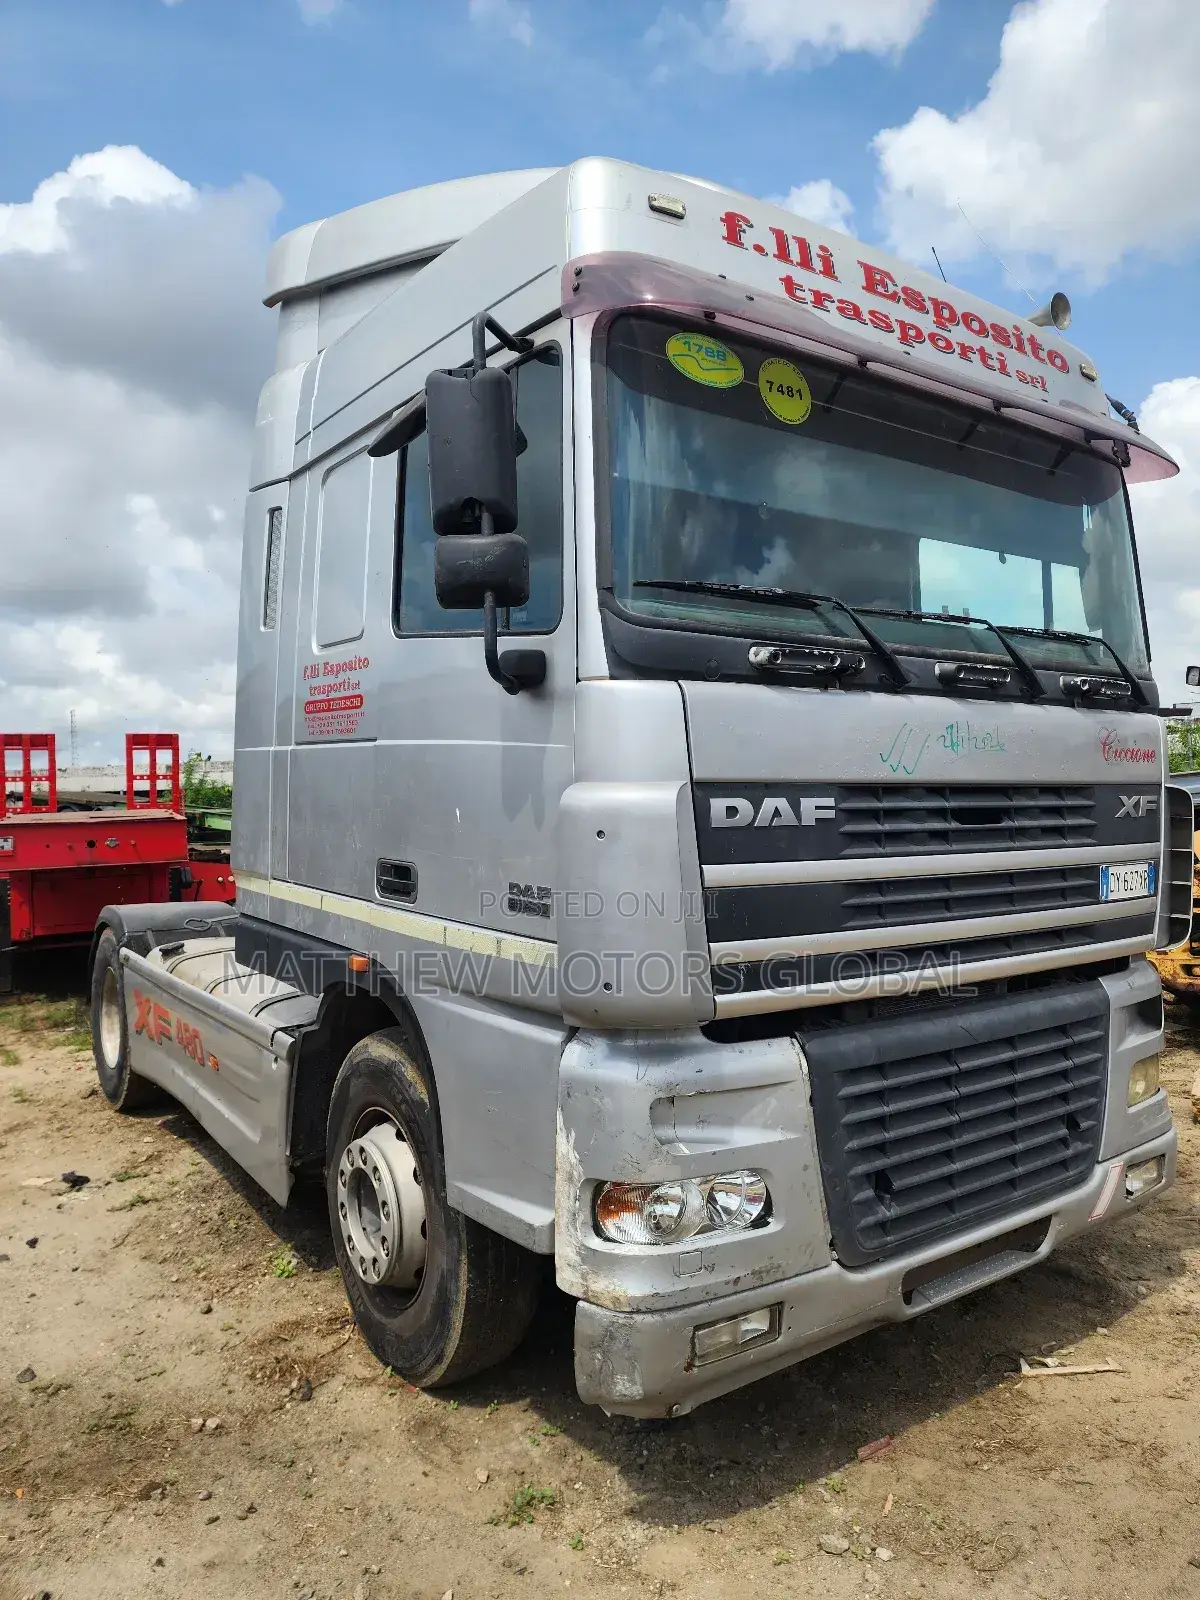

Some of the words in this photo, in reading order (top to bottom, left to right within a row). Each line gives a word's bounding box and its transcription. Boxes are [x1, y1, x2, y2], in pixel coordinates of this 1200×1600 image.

[720, 211, 841, 283] f.lli
[857, 259, 1071, 374] Esposito
[779, 274, 1012, 378] trasporti
[1015, 369, 1050, 393] srl
[765, 379, 804, 401] 7481
[323, 655, 370, 678] Esposito
[308, 677, 350, 697] trasporti
[305, 701, 328, 712] GRUPPO
[330, 697, 361, 709] TEDESCHI
[709, 798, 836, 828] DAF
[1114, 795, 1158, 819] XF
[508, 881, 552, 901] DAF
[133, 987, 173, 1046] XF
